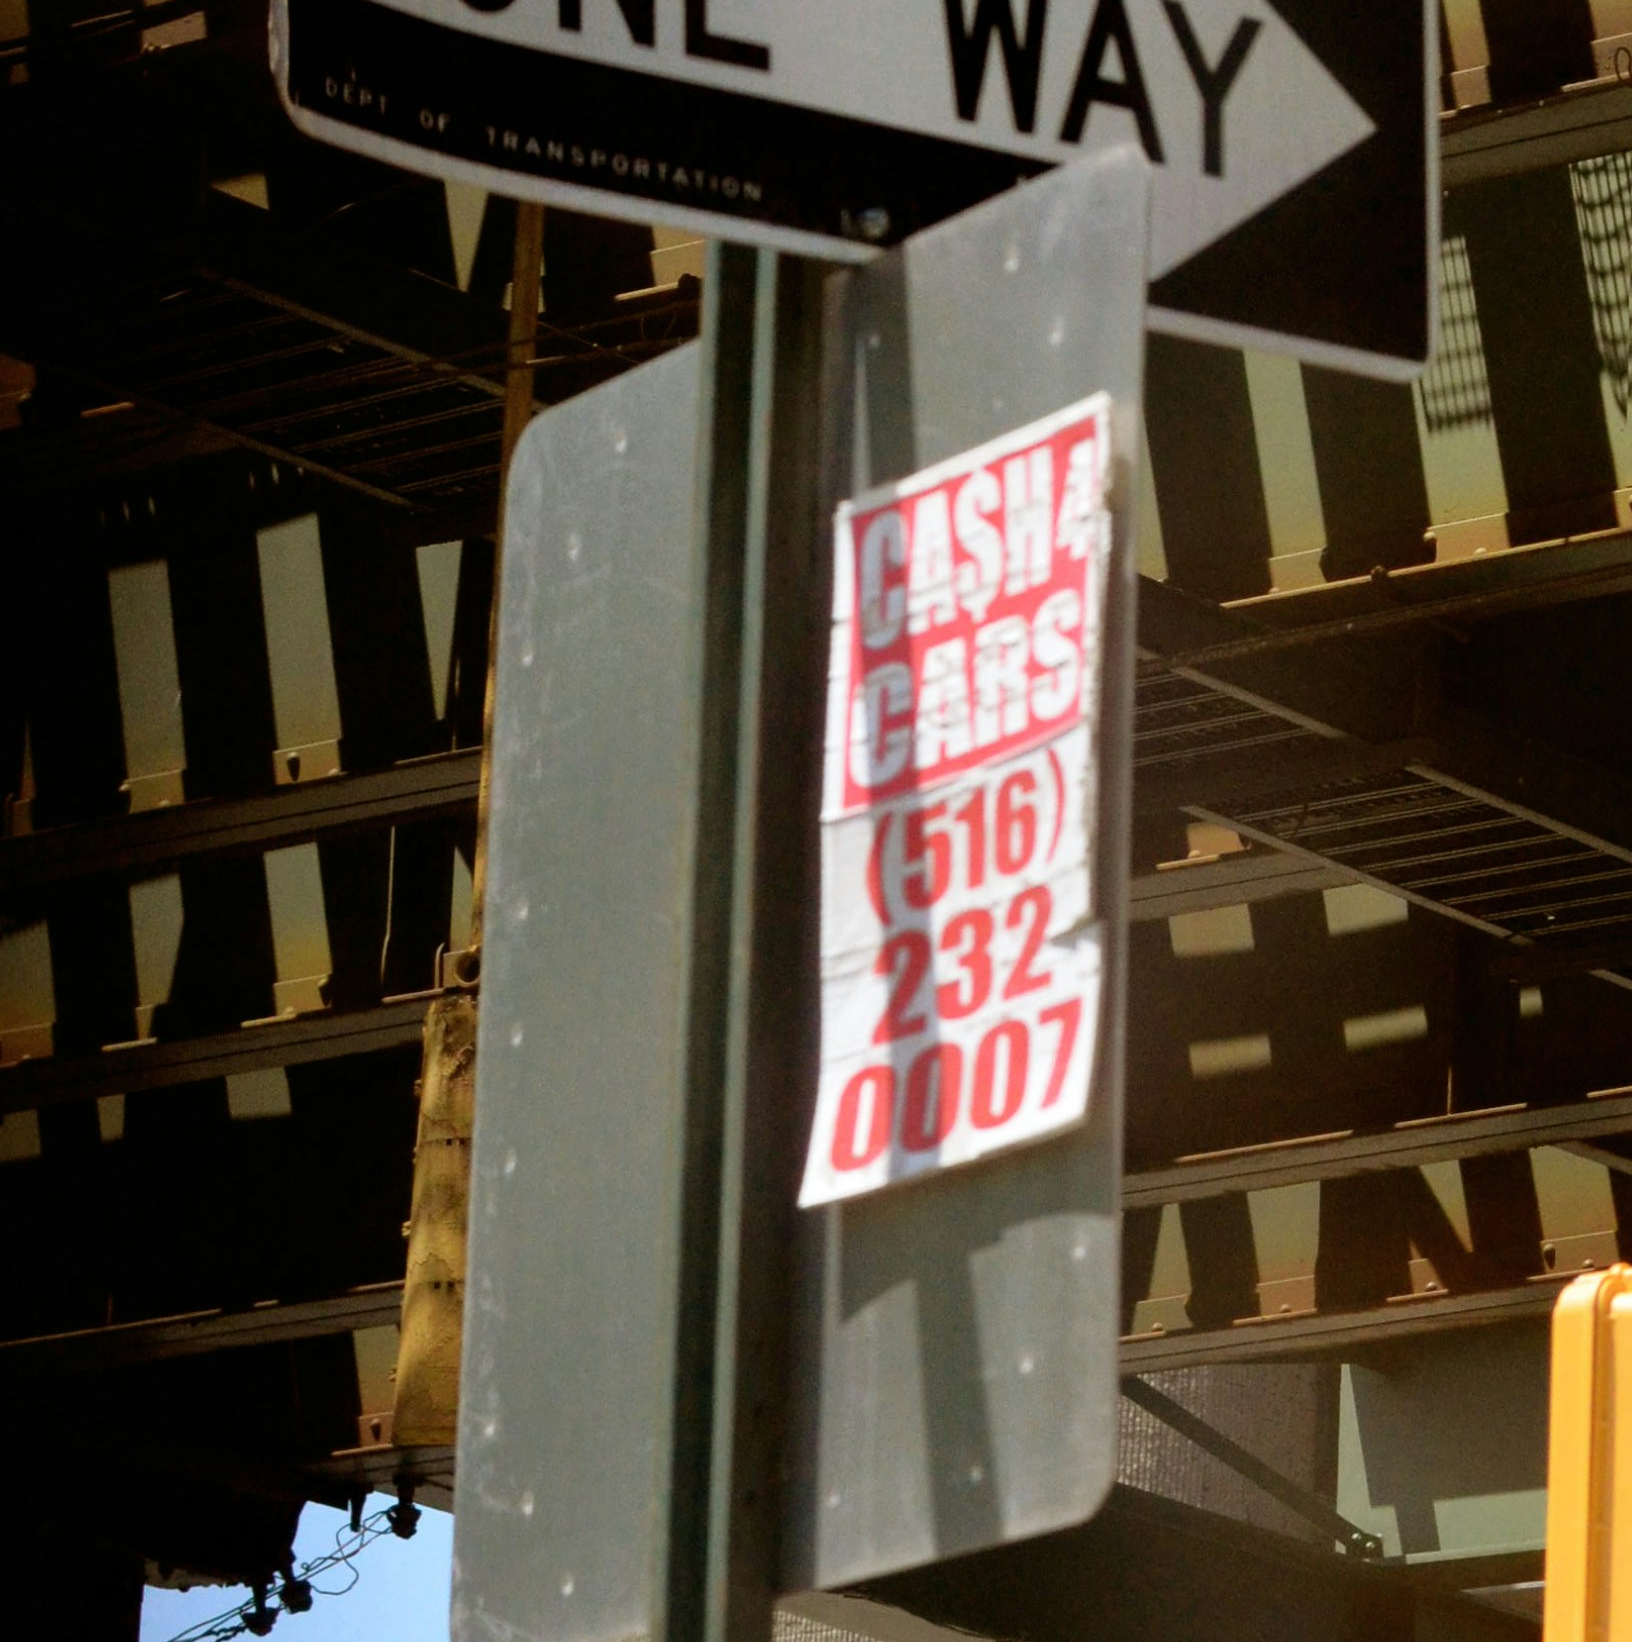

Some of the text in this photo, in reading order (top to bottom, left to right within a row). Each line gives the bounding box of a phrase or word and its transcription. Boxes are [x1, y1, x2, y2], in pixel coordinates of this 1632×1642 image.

[325, 76, 762, 200] DEPT OF TRANSPORTATION
[849, 587, 1082, 788] CARS
[866, 748, 1066, 927] (516)
[871, 884, 1053, 1046] 232
[830, 998, 1083, 1172] 0007
